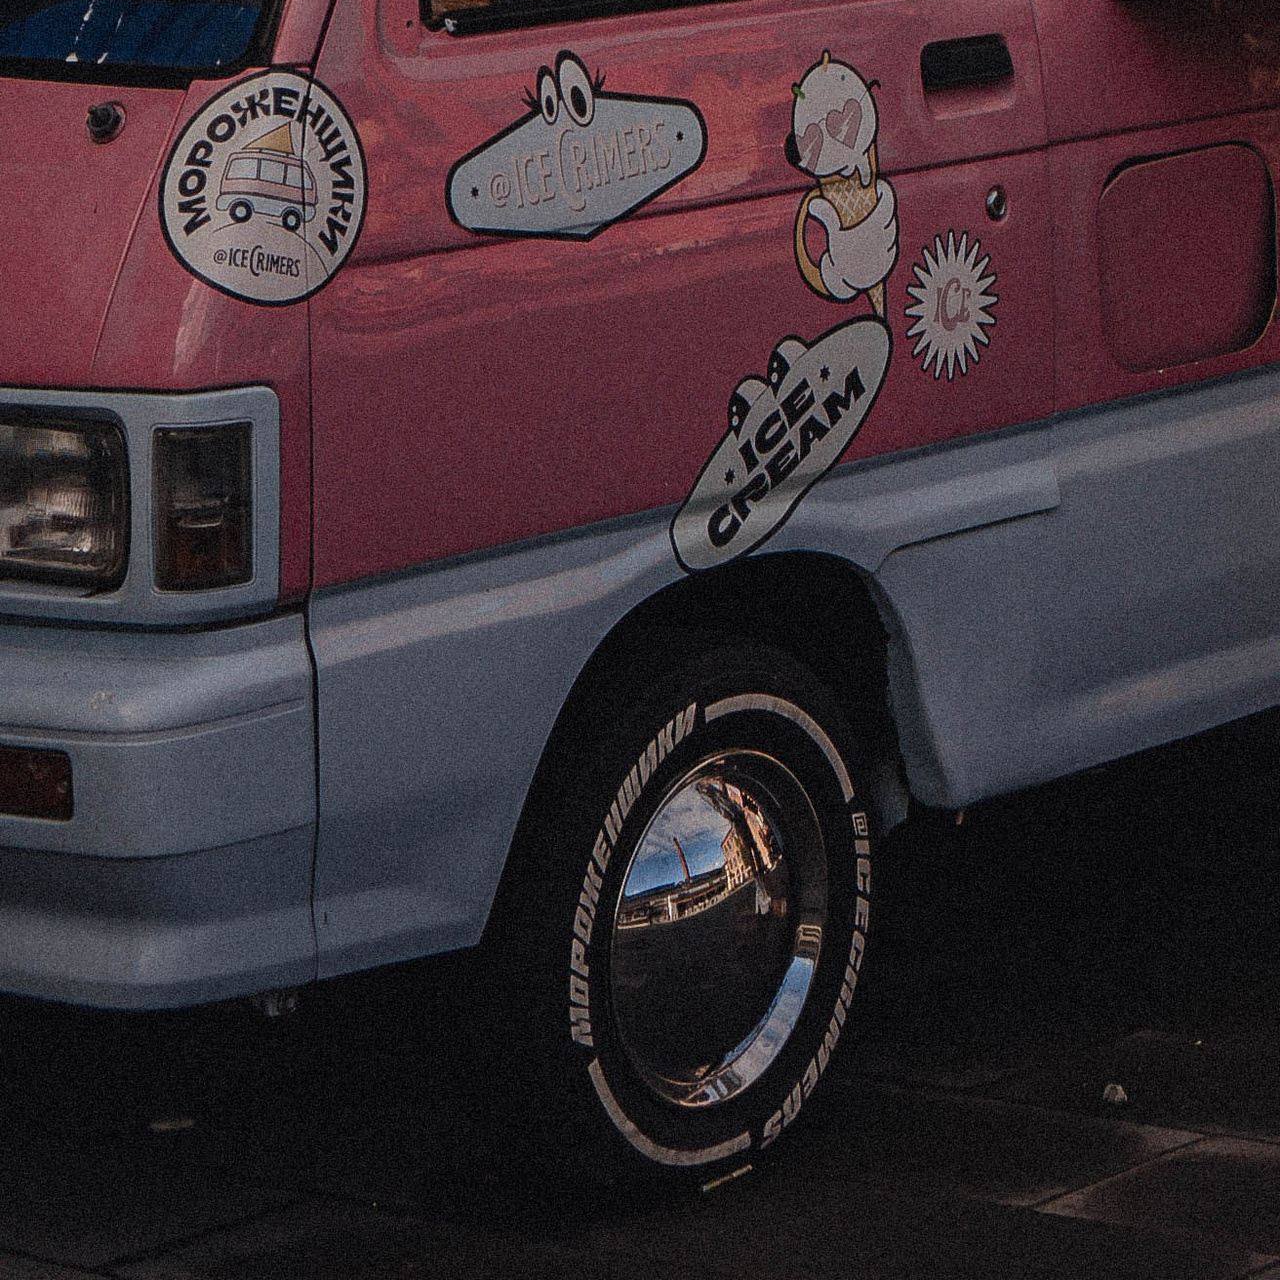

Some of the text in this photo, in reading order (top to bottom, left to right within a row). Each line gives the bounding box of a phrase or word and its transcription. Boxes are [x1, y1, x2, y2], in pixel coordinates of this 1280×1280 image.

[178, 87, 354, 257] МОРОЖЕНЩИКИ
[488, 122, 672, 212] @ICECRIMERS
[213, 245, 301, 277] @ICECRIMERS
[932, 278, 971, 333] ICE
[707, 366, 866, 549] CREAM
[739, 377, 816, 476] ICE
[760, 811, 871, 1150] @ICECRIMERS
